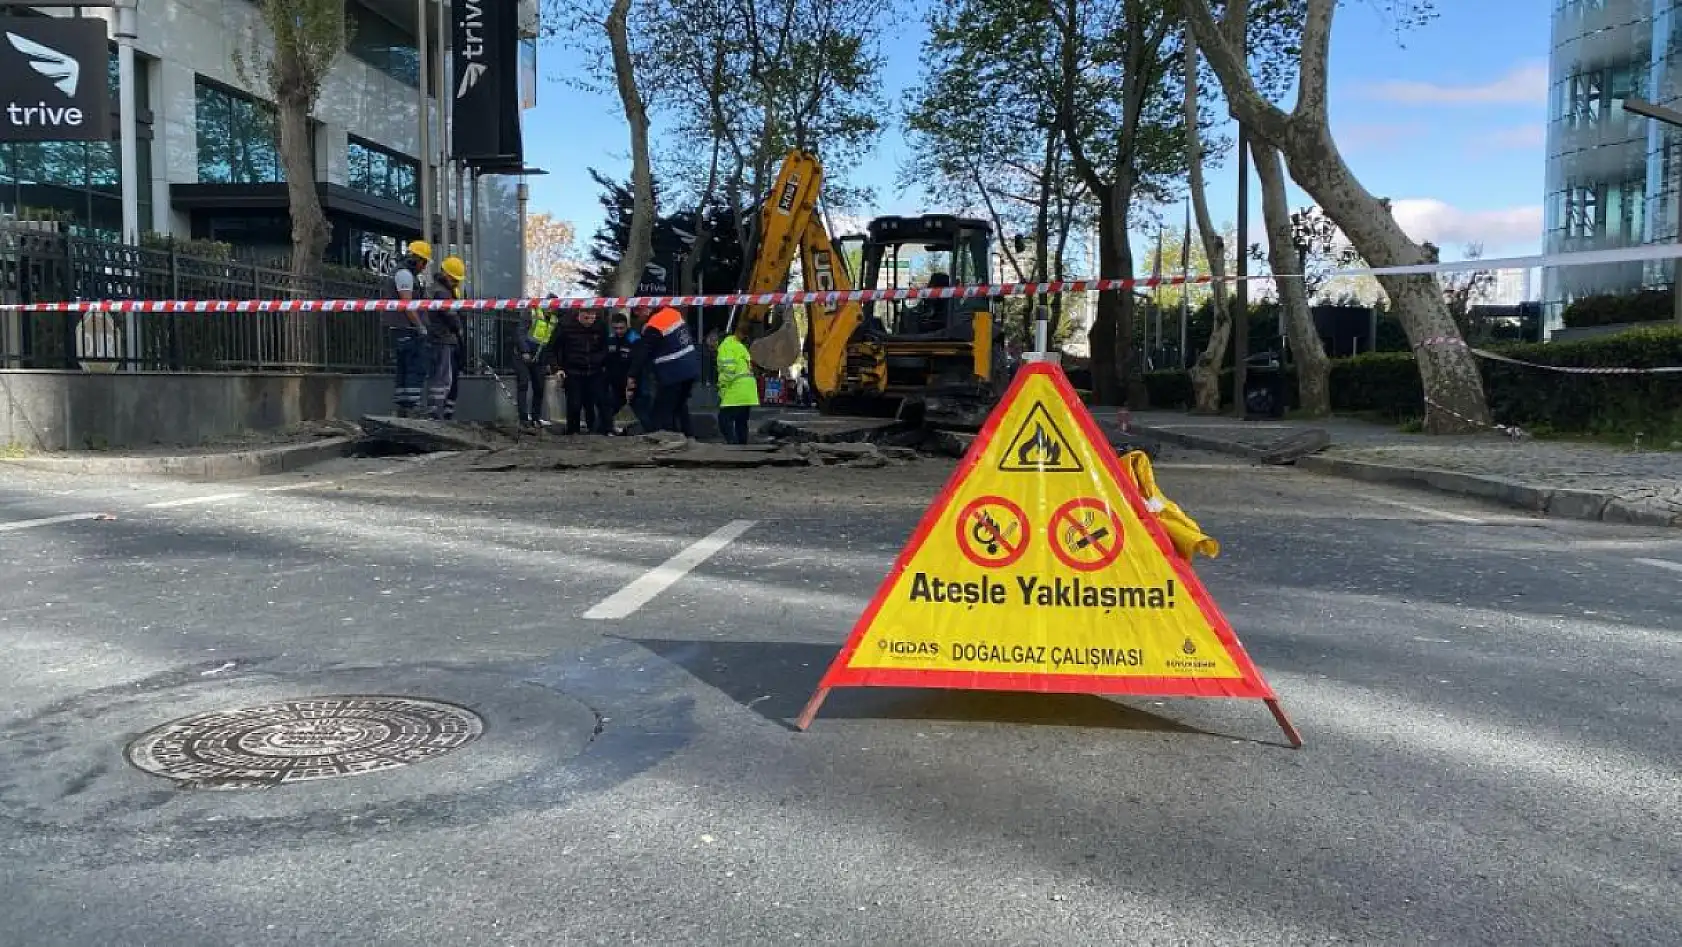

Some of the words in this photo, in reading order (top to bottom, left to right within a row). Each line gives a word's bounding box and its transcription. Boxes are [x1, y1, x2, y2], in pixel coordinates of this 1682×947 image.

[459, 0, 483, 60] triv
[6, 101, 83, 125] trive
[909, 572, 1006, 610] Ateşle
[1016, 576, 1175, 614] Yaklaşma!
[951, 641, 1046, 663] DOĞALGAZ
[1051, 646, 1143, 669] ÇALIŞMASI
